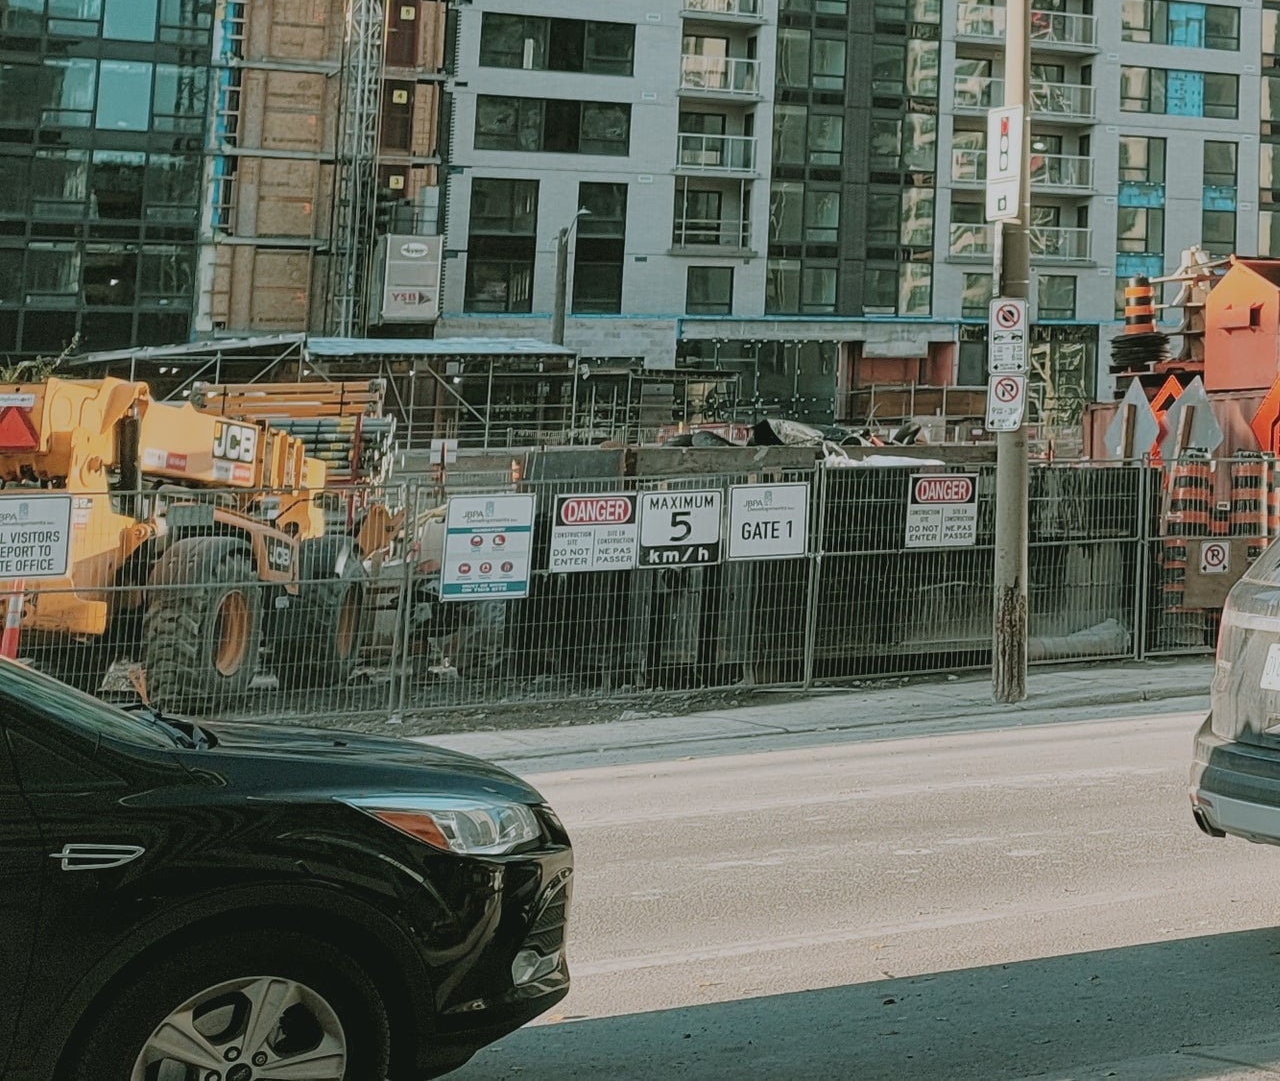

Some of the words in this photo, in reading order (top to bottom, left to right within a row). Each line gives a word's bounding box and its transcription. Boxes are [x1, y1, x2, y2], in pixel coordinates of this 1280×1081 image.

[213, 422, 255, 462] JCB
[921, 480, 967, 500] DANGER
[650, 495, 714, 510] MAXIMUM
[567, 500, 625, 521] DANGER
[669, 511, 692, 542] 5
[741, 521, 780, 540] GATE
[786, 520, 793, 539] 1
[908, 525, 920, 533] DO
[10, 531, 60, 543] VISITORS
[909, 533, 937, 542] ENTER
[943, 532, 973, 540] PASSER
[0, 545, 36, 559] EPORT
[38, 545, 51, 557] TO
[553, 548, 567, 557] DO
[569, 547, 590, 557] NOT
[598, 548, 611, 556] NE
[613, 547, 632, 555] PAS
[649, 546, 709, 564] km/h
[15, 558, 54, 571] OFFICE
[553, 557, 588, 567] ENTER
[596, 556, 632, 564] PASSER
